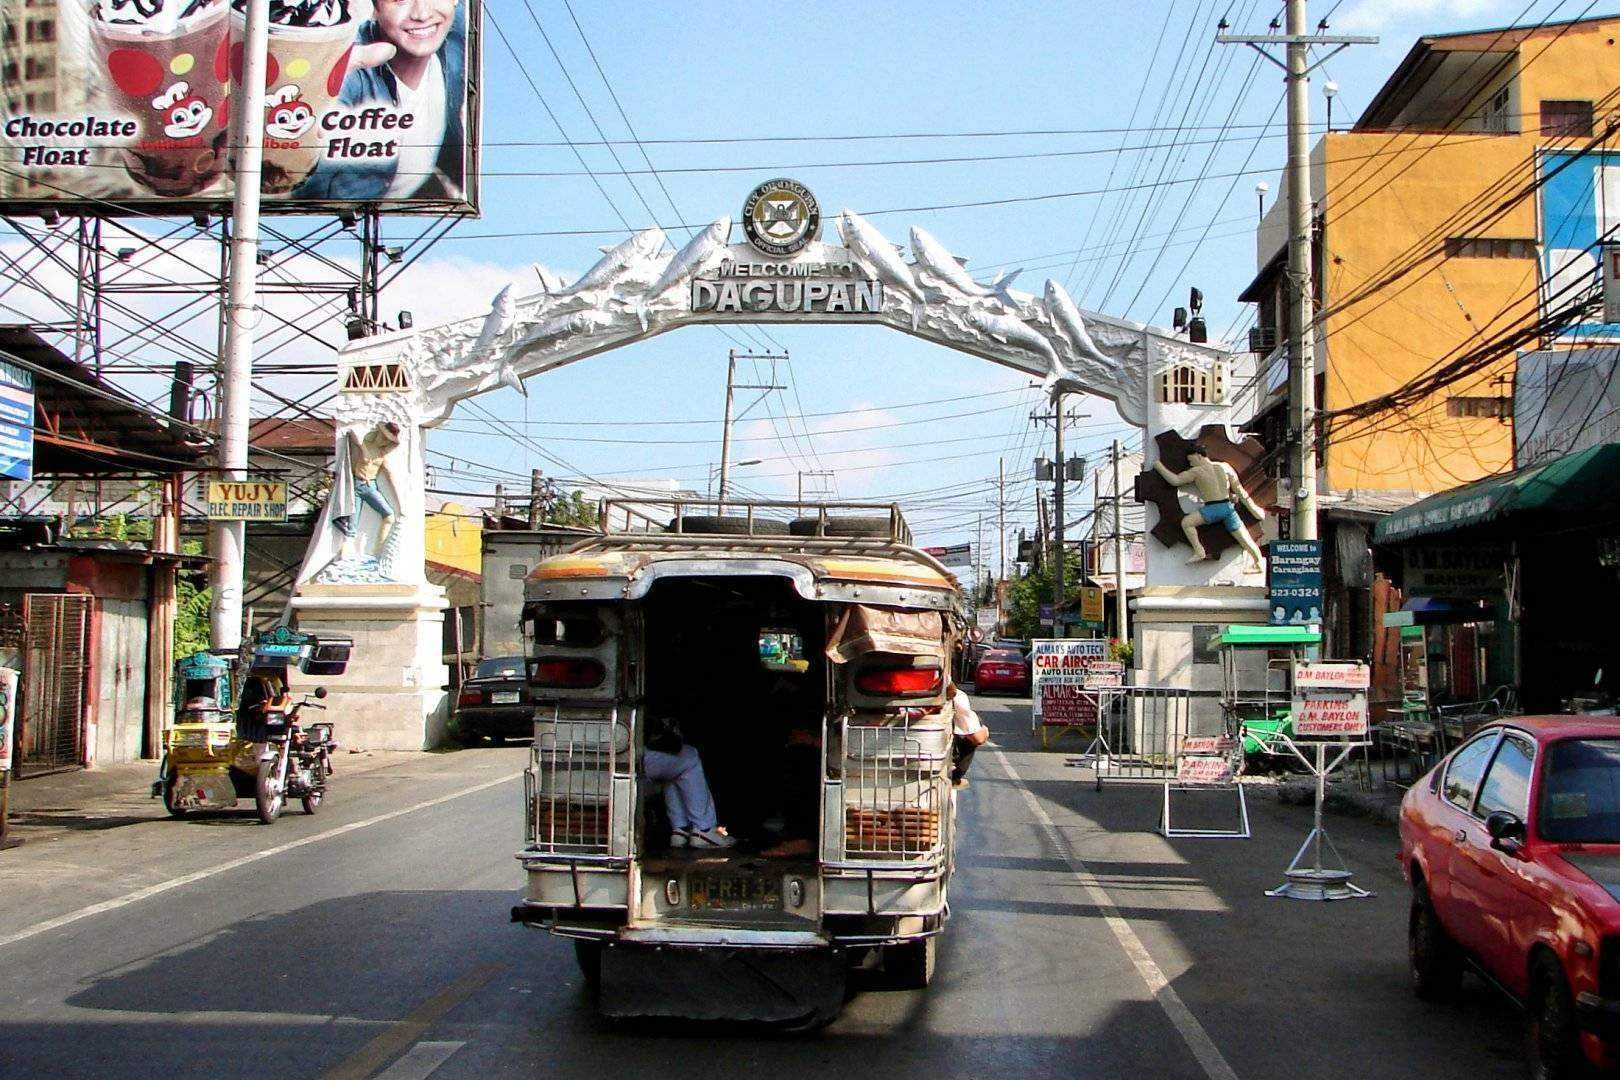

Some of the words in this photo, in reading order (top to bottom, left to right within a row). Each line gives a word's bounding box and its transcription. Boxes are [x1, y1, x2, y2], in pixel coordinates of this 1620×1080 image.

[321, 109, 414, 131] Coffee
[5, 117, 137, 138] Chocolate
[326, 137, 397, 159] Float
[22, 145, 90, 167] Float
[720, 260, 821, 278] WELCOME
[692, 279, 883, 313] DAGUPAN
[218, 484, 279, 501] YUJY
[232, 502, 262, 517] REPAIR
[264, 502, 286, 518] SHOP
[1276, 544, 1309, 552] WELCOME
[1271, 555, 1322, 566] Barangay
[1271, 588, 1319, 597] 523-0324
[1036, 644, 1064, 654] ALMAR'S
[1067, 645, 1085, 654] AUTO
[1086, 645, 1104, 654] TECH
[1036, 655, 1059, 668] CAR
[1041, 668, 1061, 676] AUTO
[1315, 670, 1345, 680] BAYLON
[1321, 711, 1360, 720] BAYLON
